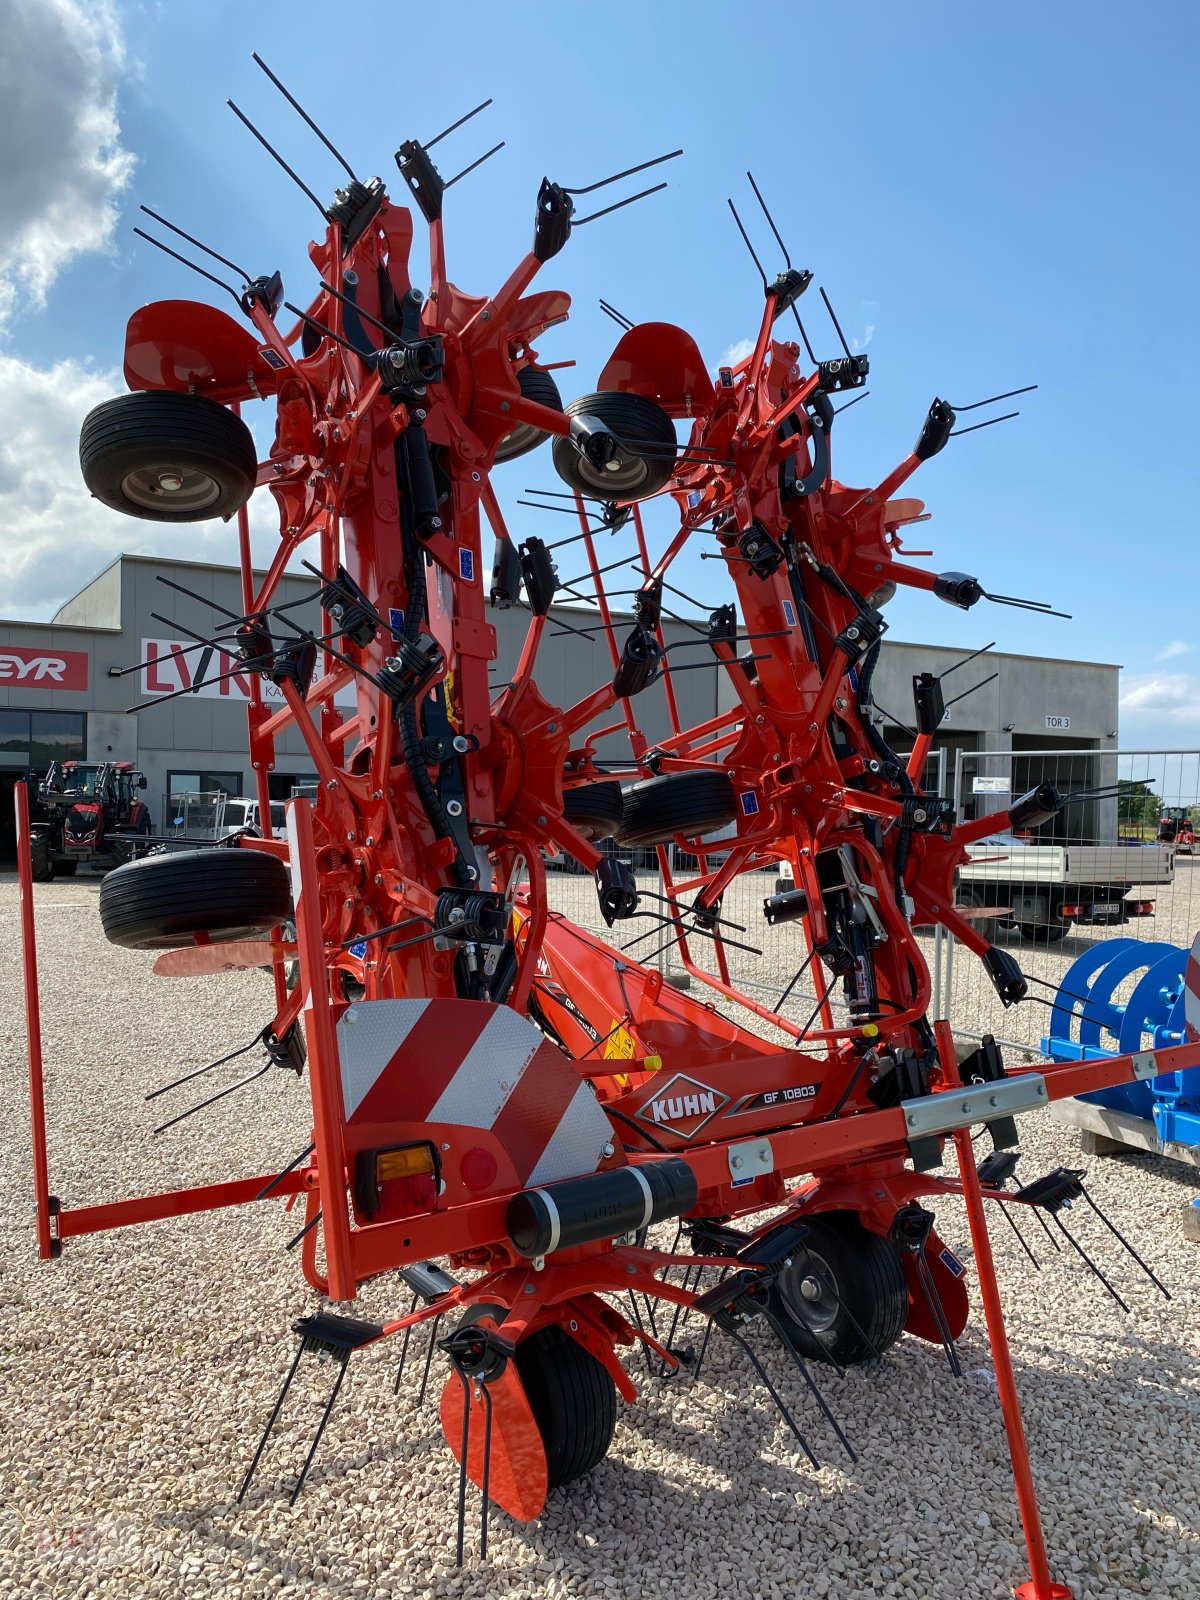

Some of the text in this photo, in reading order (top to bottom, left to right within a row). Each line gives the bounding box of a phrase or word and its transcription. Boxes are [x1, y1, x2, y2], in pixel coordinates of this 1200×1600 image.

[944, 709, 950, 720] 2
[1046, 717, 1069, 728] TOR 3
[763, 1085, 816, 1104] GF 10803
[651, 1091, 716, 1123] KUHN
